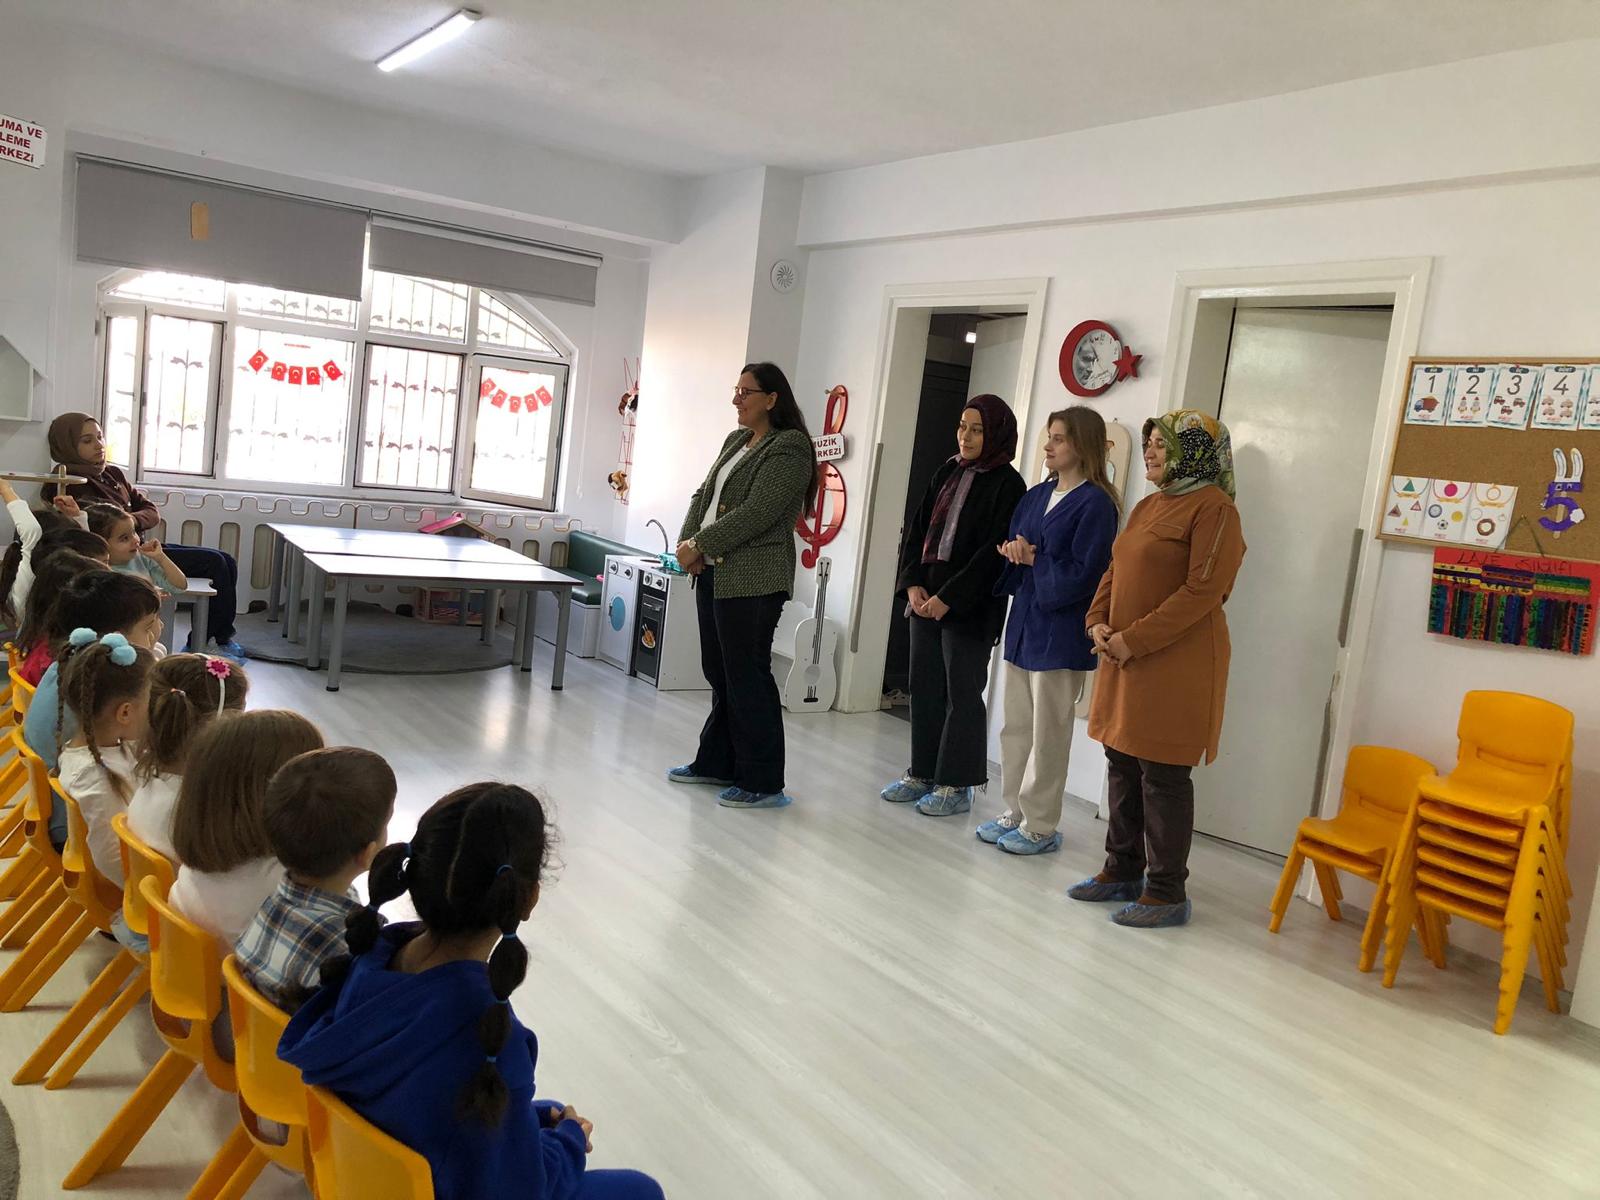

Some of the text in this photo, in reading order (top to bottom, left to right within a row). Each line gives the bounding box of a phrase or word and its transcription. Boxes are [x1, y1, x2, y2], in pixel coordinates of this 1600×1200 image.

[27, 126, 42, 139] VE
[1428, 374, 1436, 393] 1
[1466, 374, 1480, 394] 2
[1506, 374, 1522, 395] 3
[1552, 374, 1569, 395] 4
[816, 446, 842, 458] RKEZİ
[1538, 480, 1584, 532] 5
